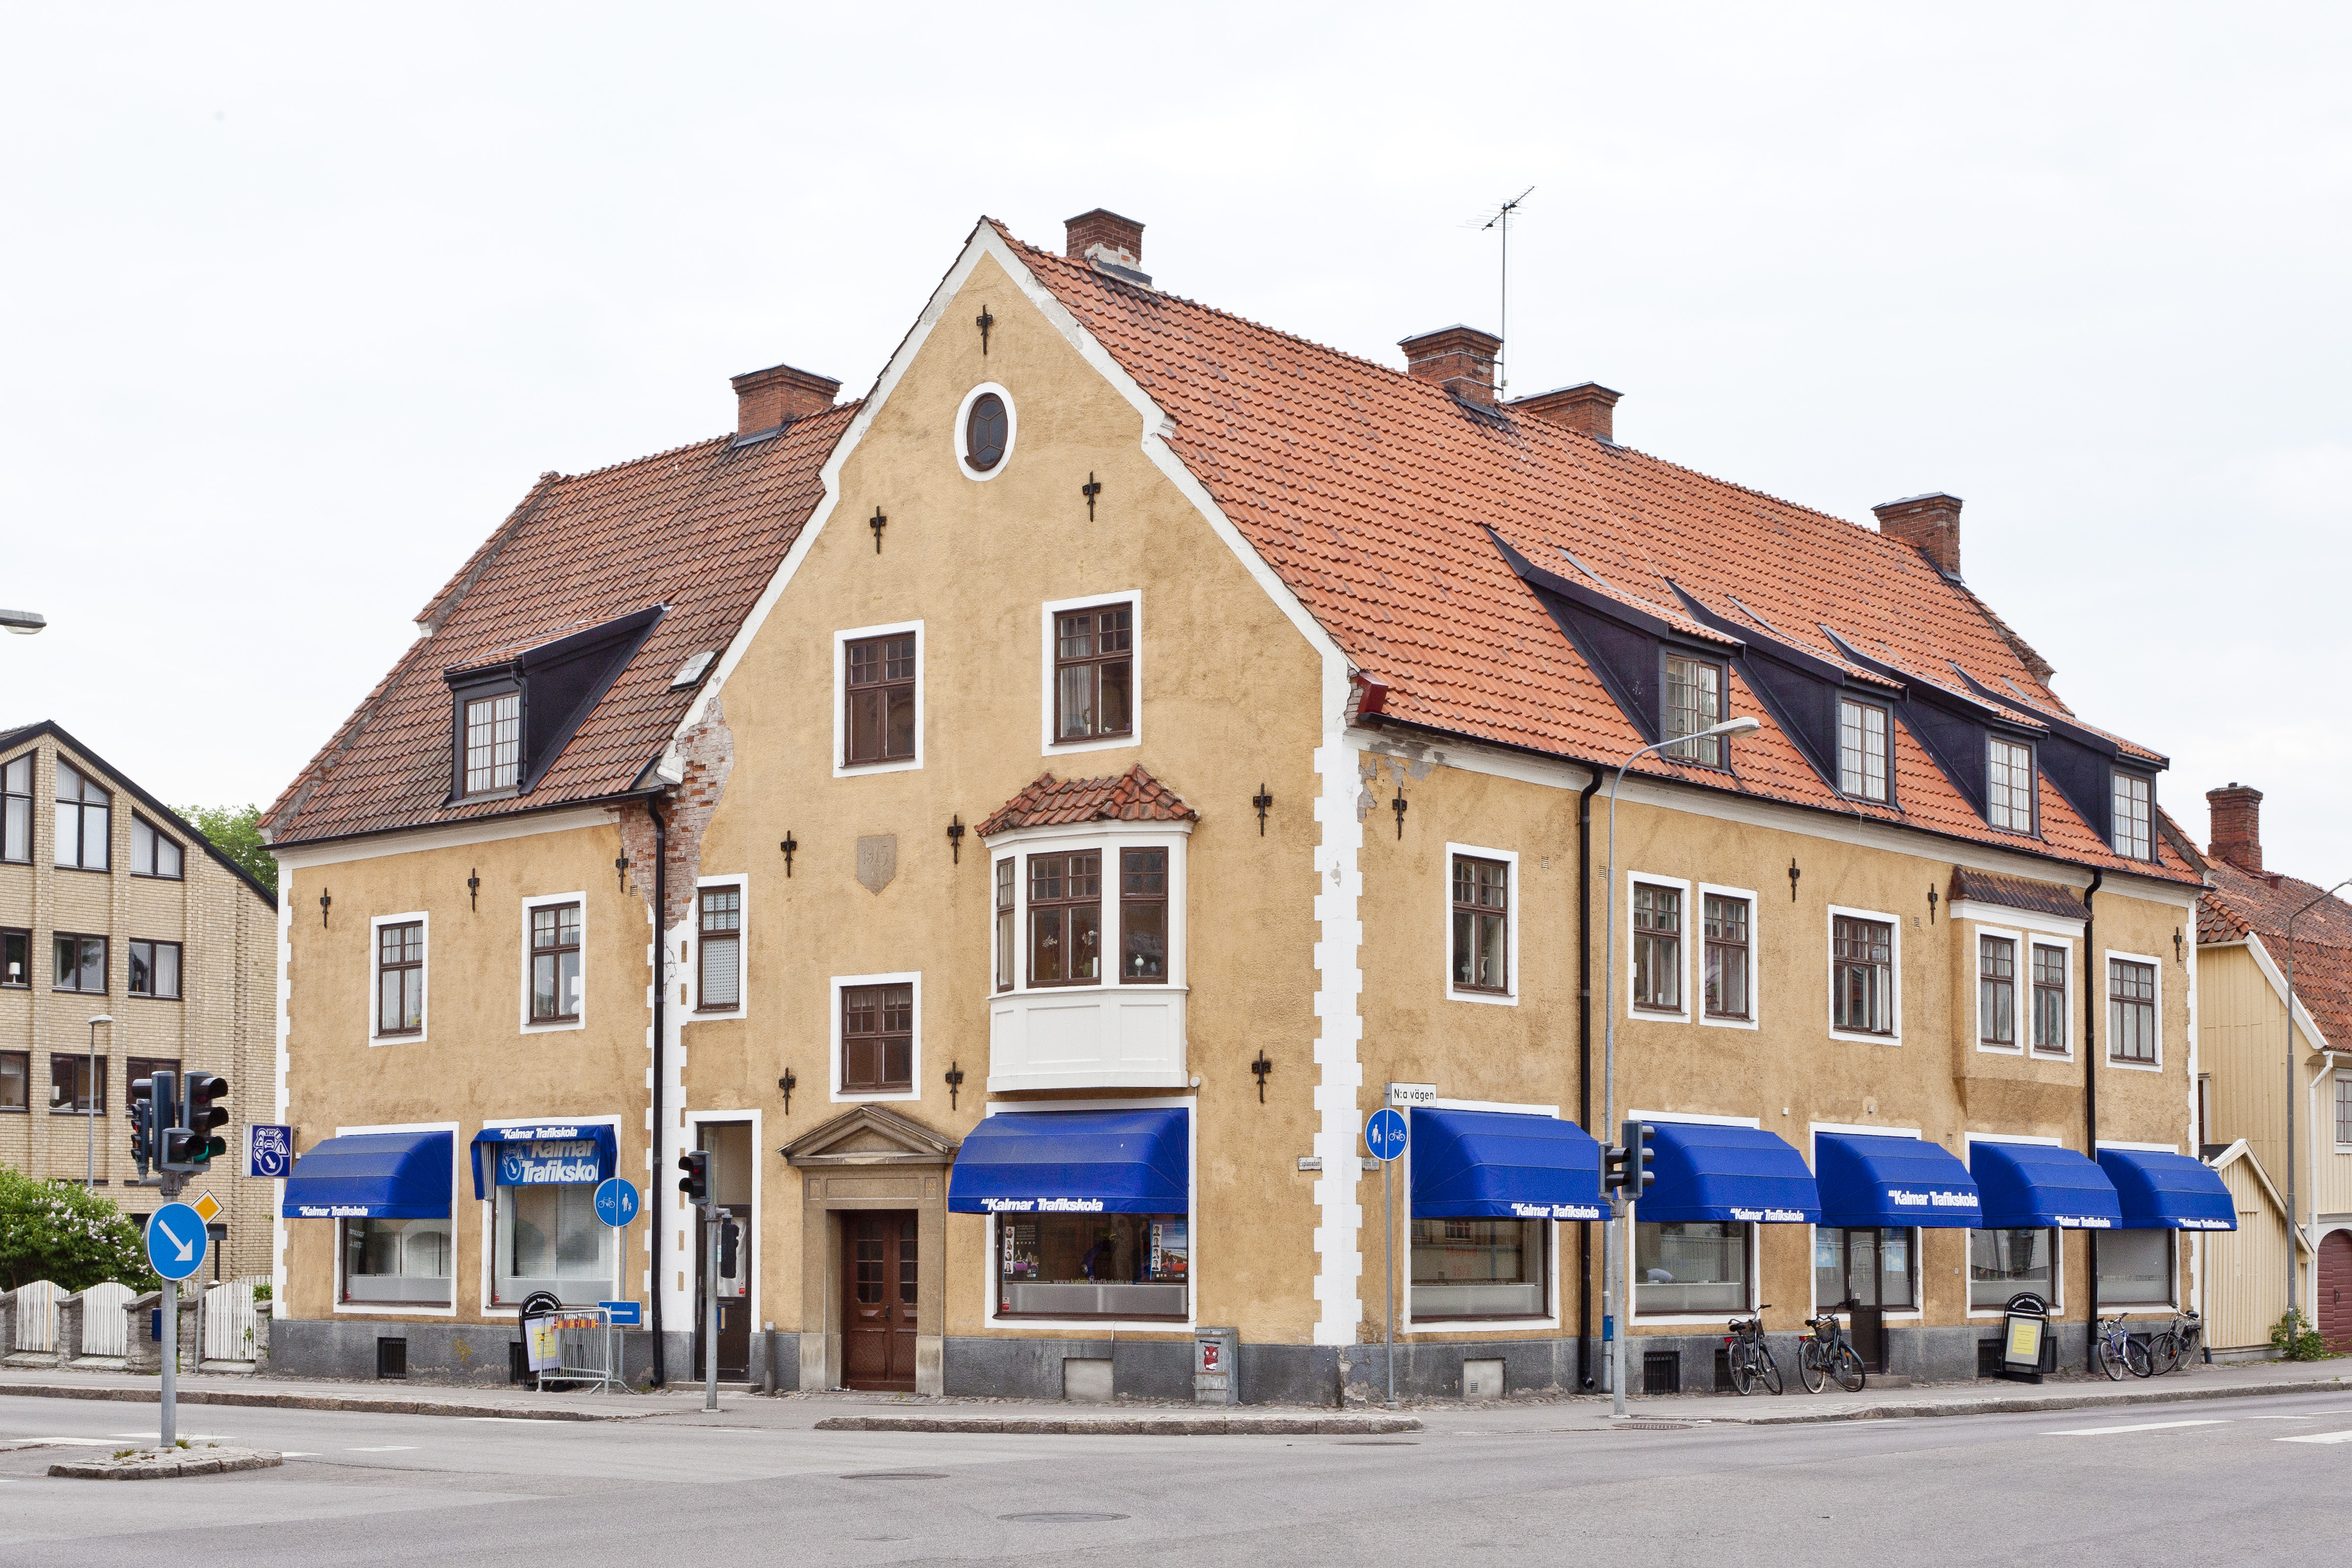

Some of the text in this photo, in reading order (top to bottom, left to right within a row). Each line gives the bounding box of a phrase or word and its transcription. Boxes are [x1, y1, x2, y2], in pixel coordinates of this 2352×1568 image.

[1394, 1089, 1434, 1102] N:a vägen
[504, 1129, 534, 1139] Kalmar
[536, 1127, 577, 1138] Trafikskola
[531, 1140, 595, 1158] Kalmar
[1299, 1159, 1320, 1168] Esplanaden
[987, 1198, 1034, 1211] Kalmar
[1037, 1198, 1103, 1211] Trafikskola
[1894, 1190, 1928, 1205] Kalmar
[1929, 1191, 1978, 1207] Trafikskola
[302, 1206, 329, 1216] Kalmar
[331, 1206, 368, 1216] Trafikskola
[1516, 1203, 1551, 1217] Kalmar
[1552, 1204, 1599, 1219] Trafikskola
[1735, 1208, 1763, 1220] Kalmar
[1765, 1209, 1804, 1221] Trafikskola
[2059, 1216, 2080, 1226] Kalmar
[2080, 1217, 2111, 1227] Trafikskola
[525, 1298, 557, 1313] Kalmar Trafikskola
[2012, 1297, 2043, 1312] Kalmar Trafikskola
